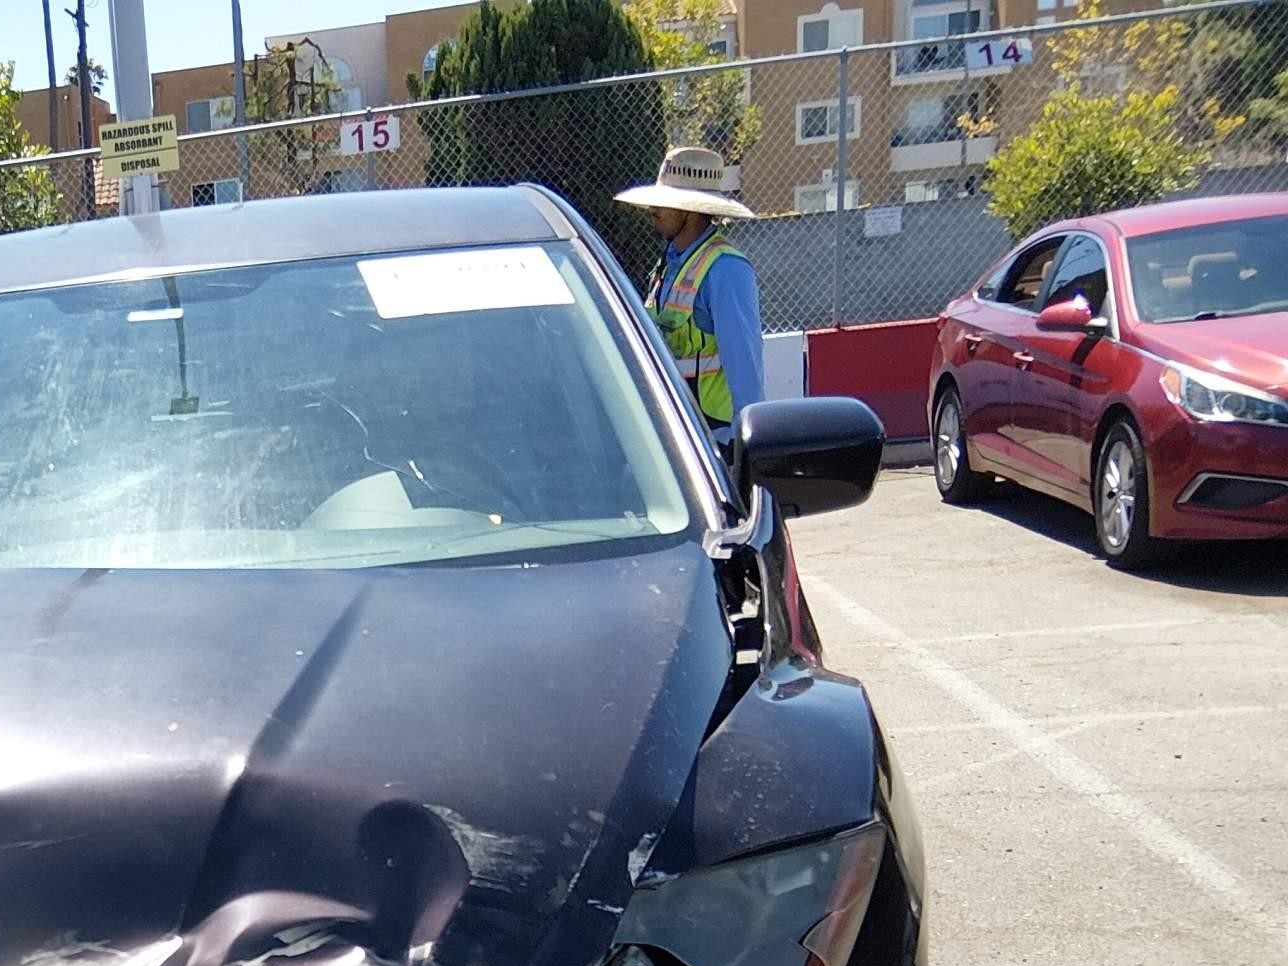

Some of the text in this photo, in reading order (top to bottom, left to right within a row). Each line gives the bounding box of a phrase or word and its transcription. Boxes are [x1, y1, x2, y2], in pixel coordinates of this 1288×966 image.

[978, 41, 1023, 65] 14
[102, 121, 173, 140] HAZARDOUS SPILL
[352, 121, 389, 151] 15
[114, 136, 163, 152] ABSORBANT
[120, 157, 160, 172] DISPOSAL
